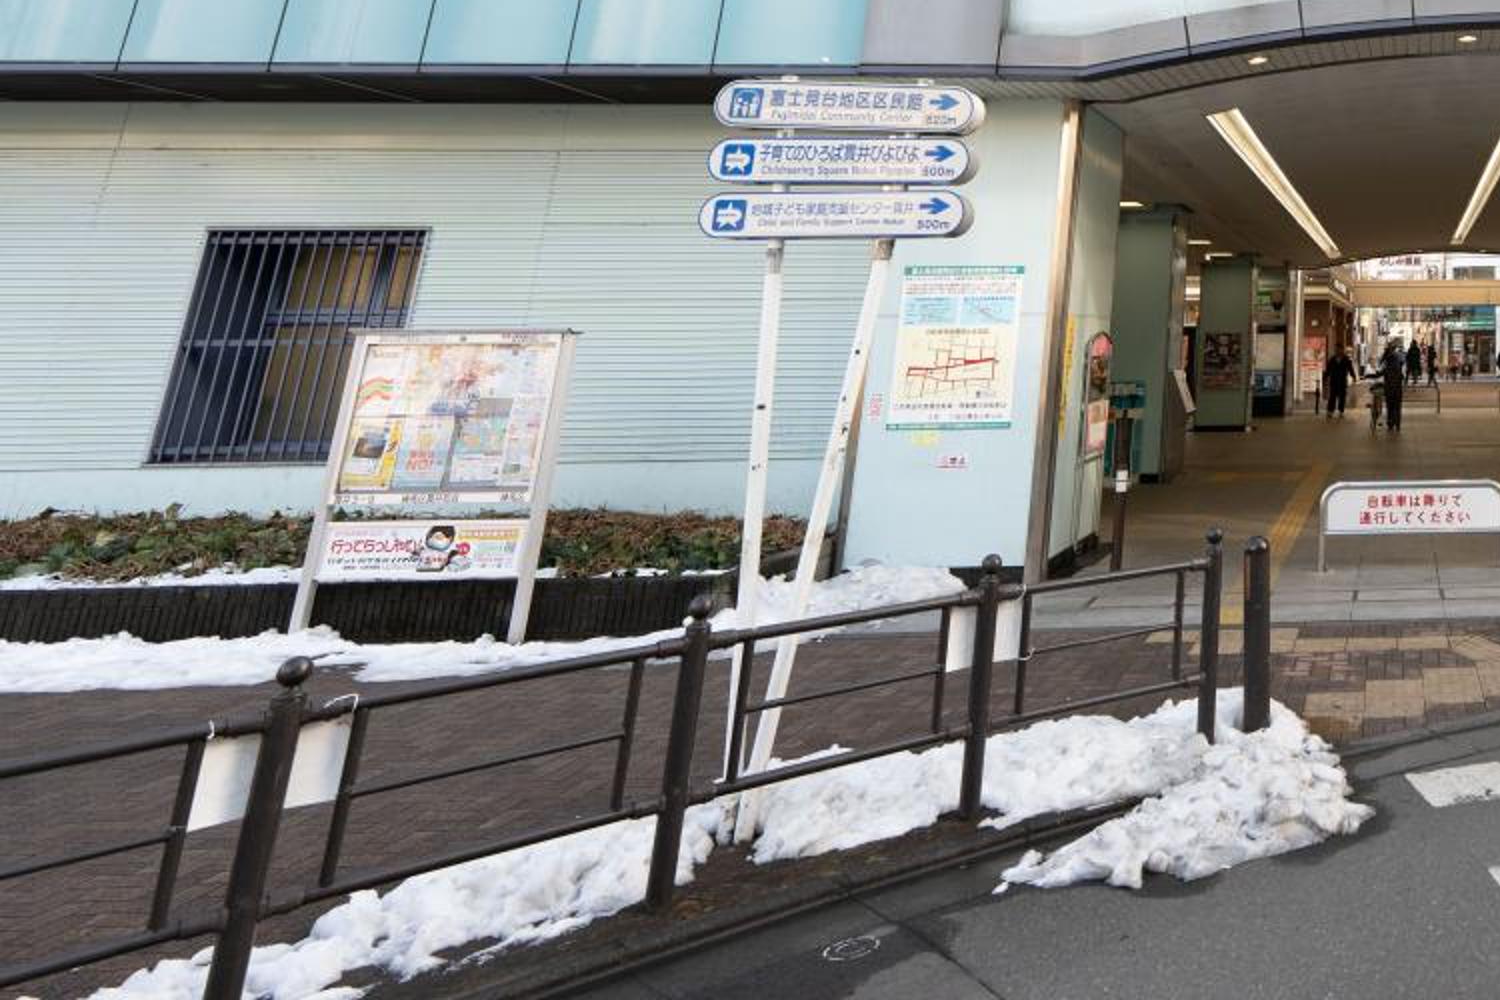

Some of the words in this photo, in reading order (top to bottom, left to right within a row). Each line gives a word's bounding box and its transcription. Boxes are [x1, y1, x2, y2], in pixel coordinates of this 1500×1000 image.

[769, 89, 924, 111] 富士見台地区区民館
[1367, 494, 1462, 508] 自転車は降りて
[1359, 511, 1471, 525] 通行してください
